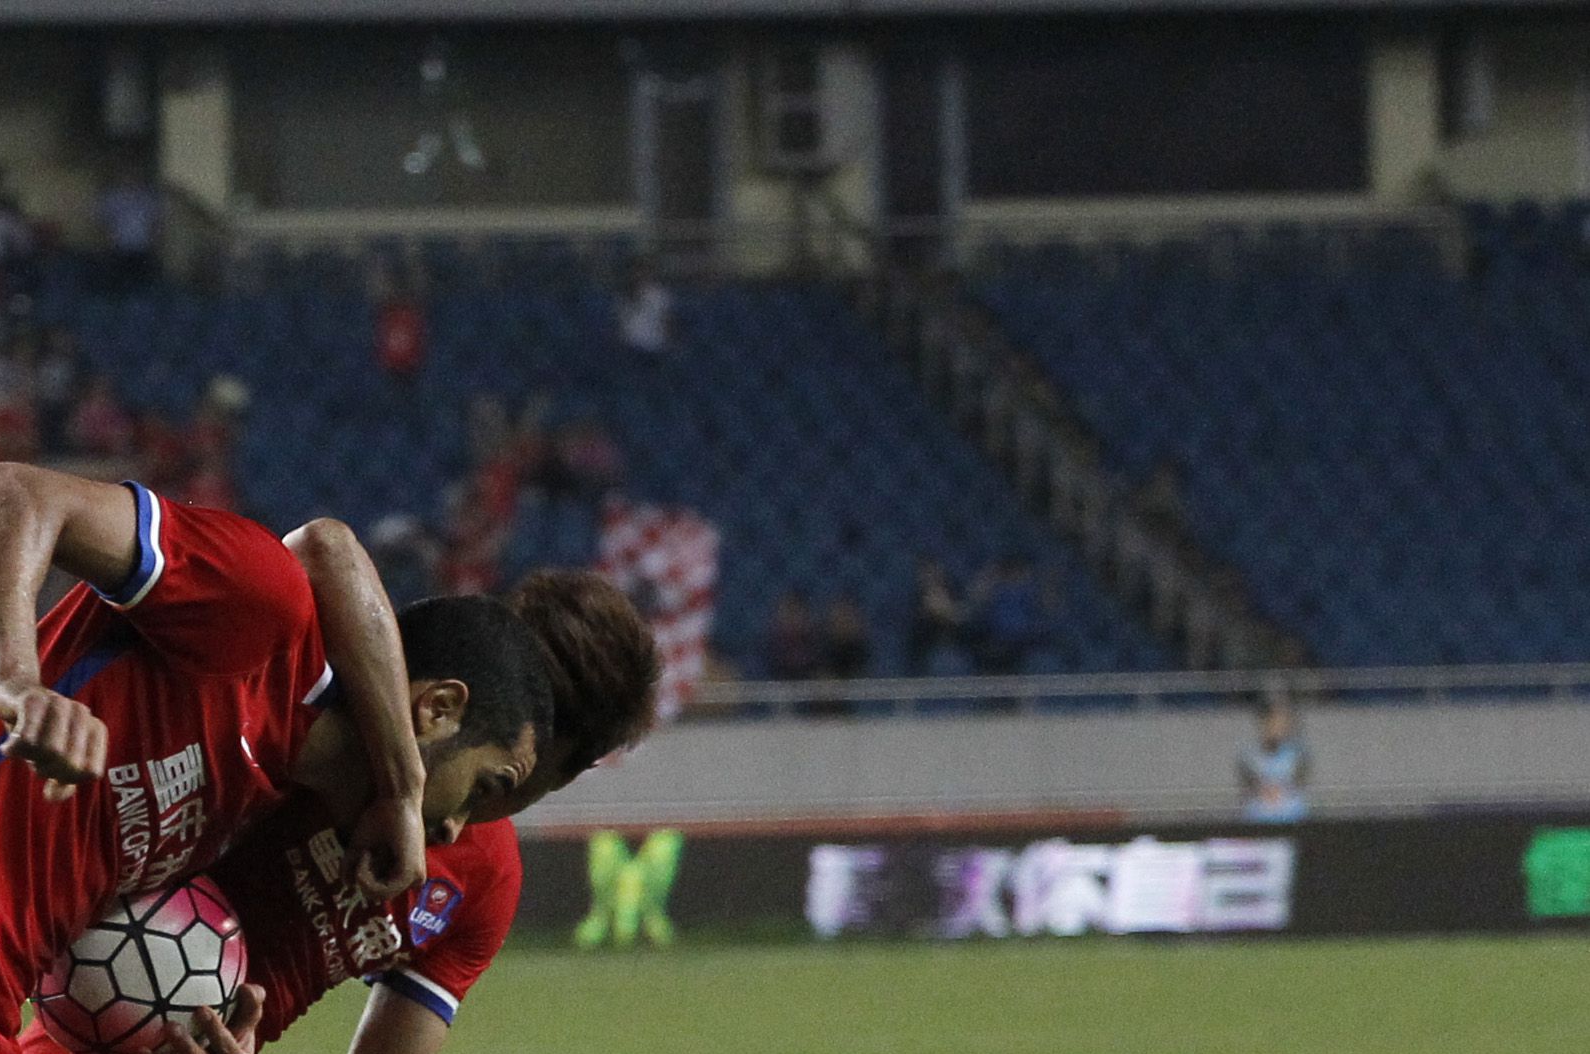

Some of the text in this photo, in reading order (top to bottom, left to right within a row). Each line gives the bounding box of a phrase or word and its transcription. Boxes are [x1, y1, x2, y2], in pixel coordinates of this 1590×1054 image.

[107, 763, 151, 834] BANK
[121, 831, 151, 860] OF
[286, 848, 325, 912] BANK
